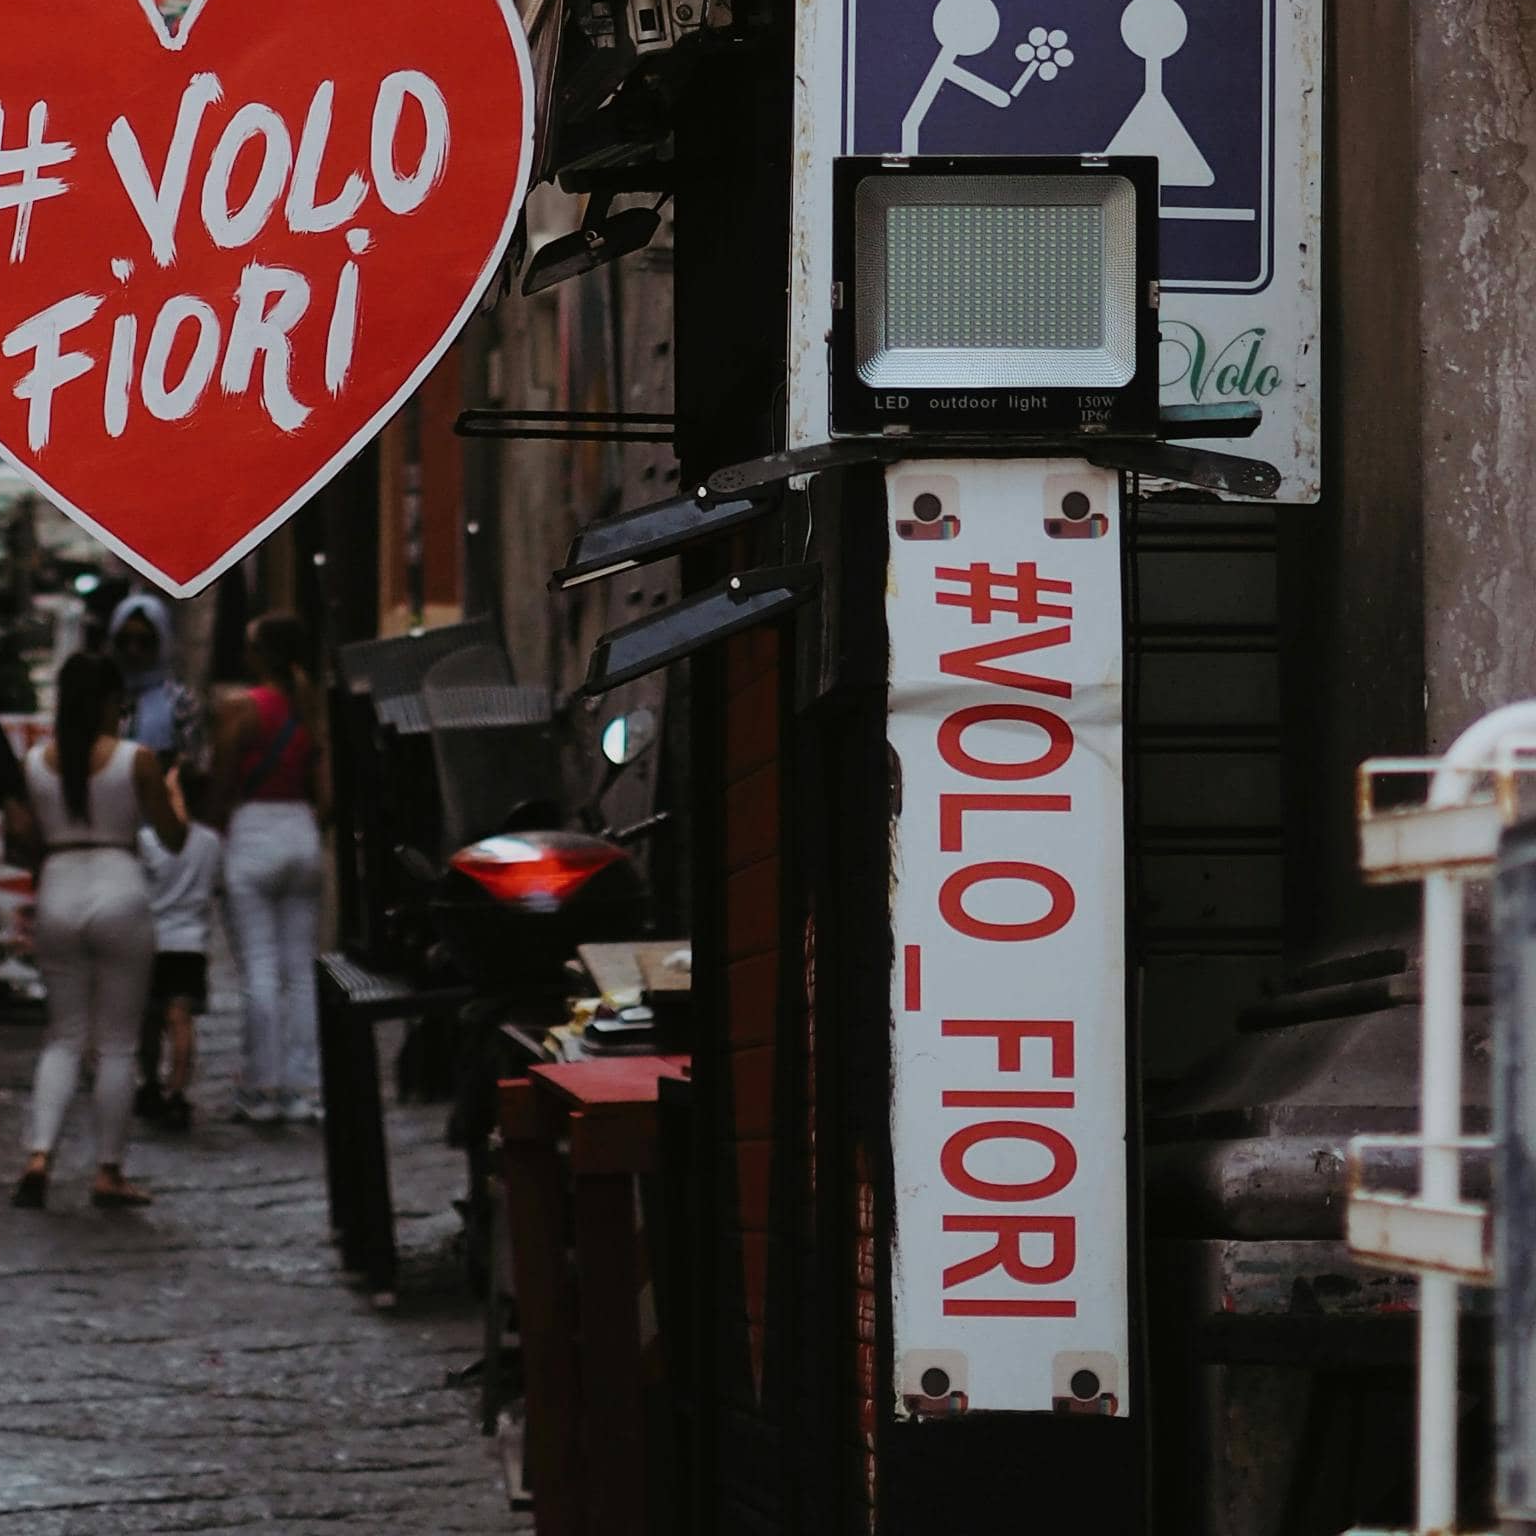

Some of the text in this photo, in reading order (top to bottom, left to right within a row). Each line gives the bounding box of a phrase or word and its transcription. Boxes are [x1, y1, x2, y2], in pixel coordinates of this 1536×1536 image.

[1159, 320, 1282, 402] Volo
[874, 394, 1116, 412] LED outdoor light 150W
[903, 561, 1077, 1318] #VOLO_FIORI
